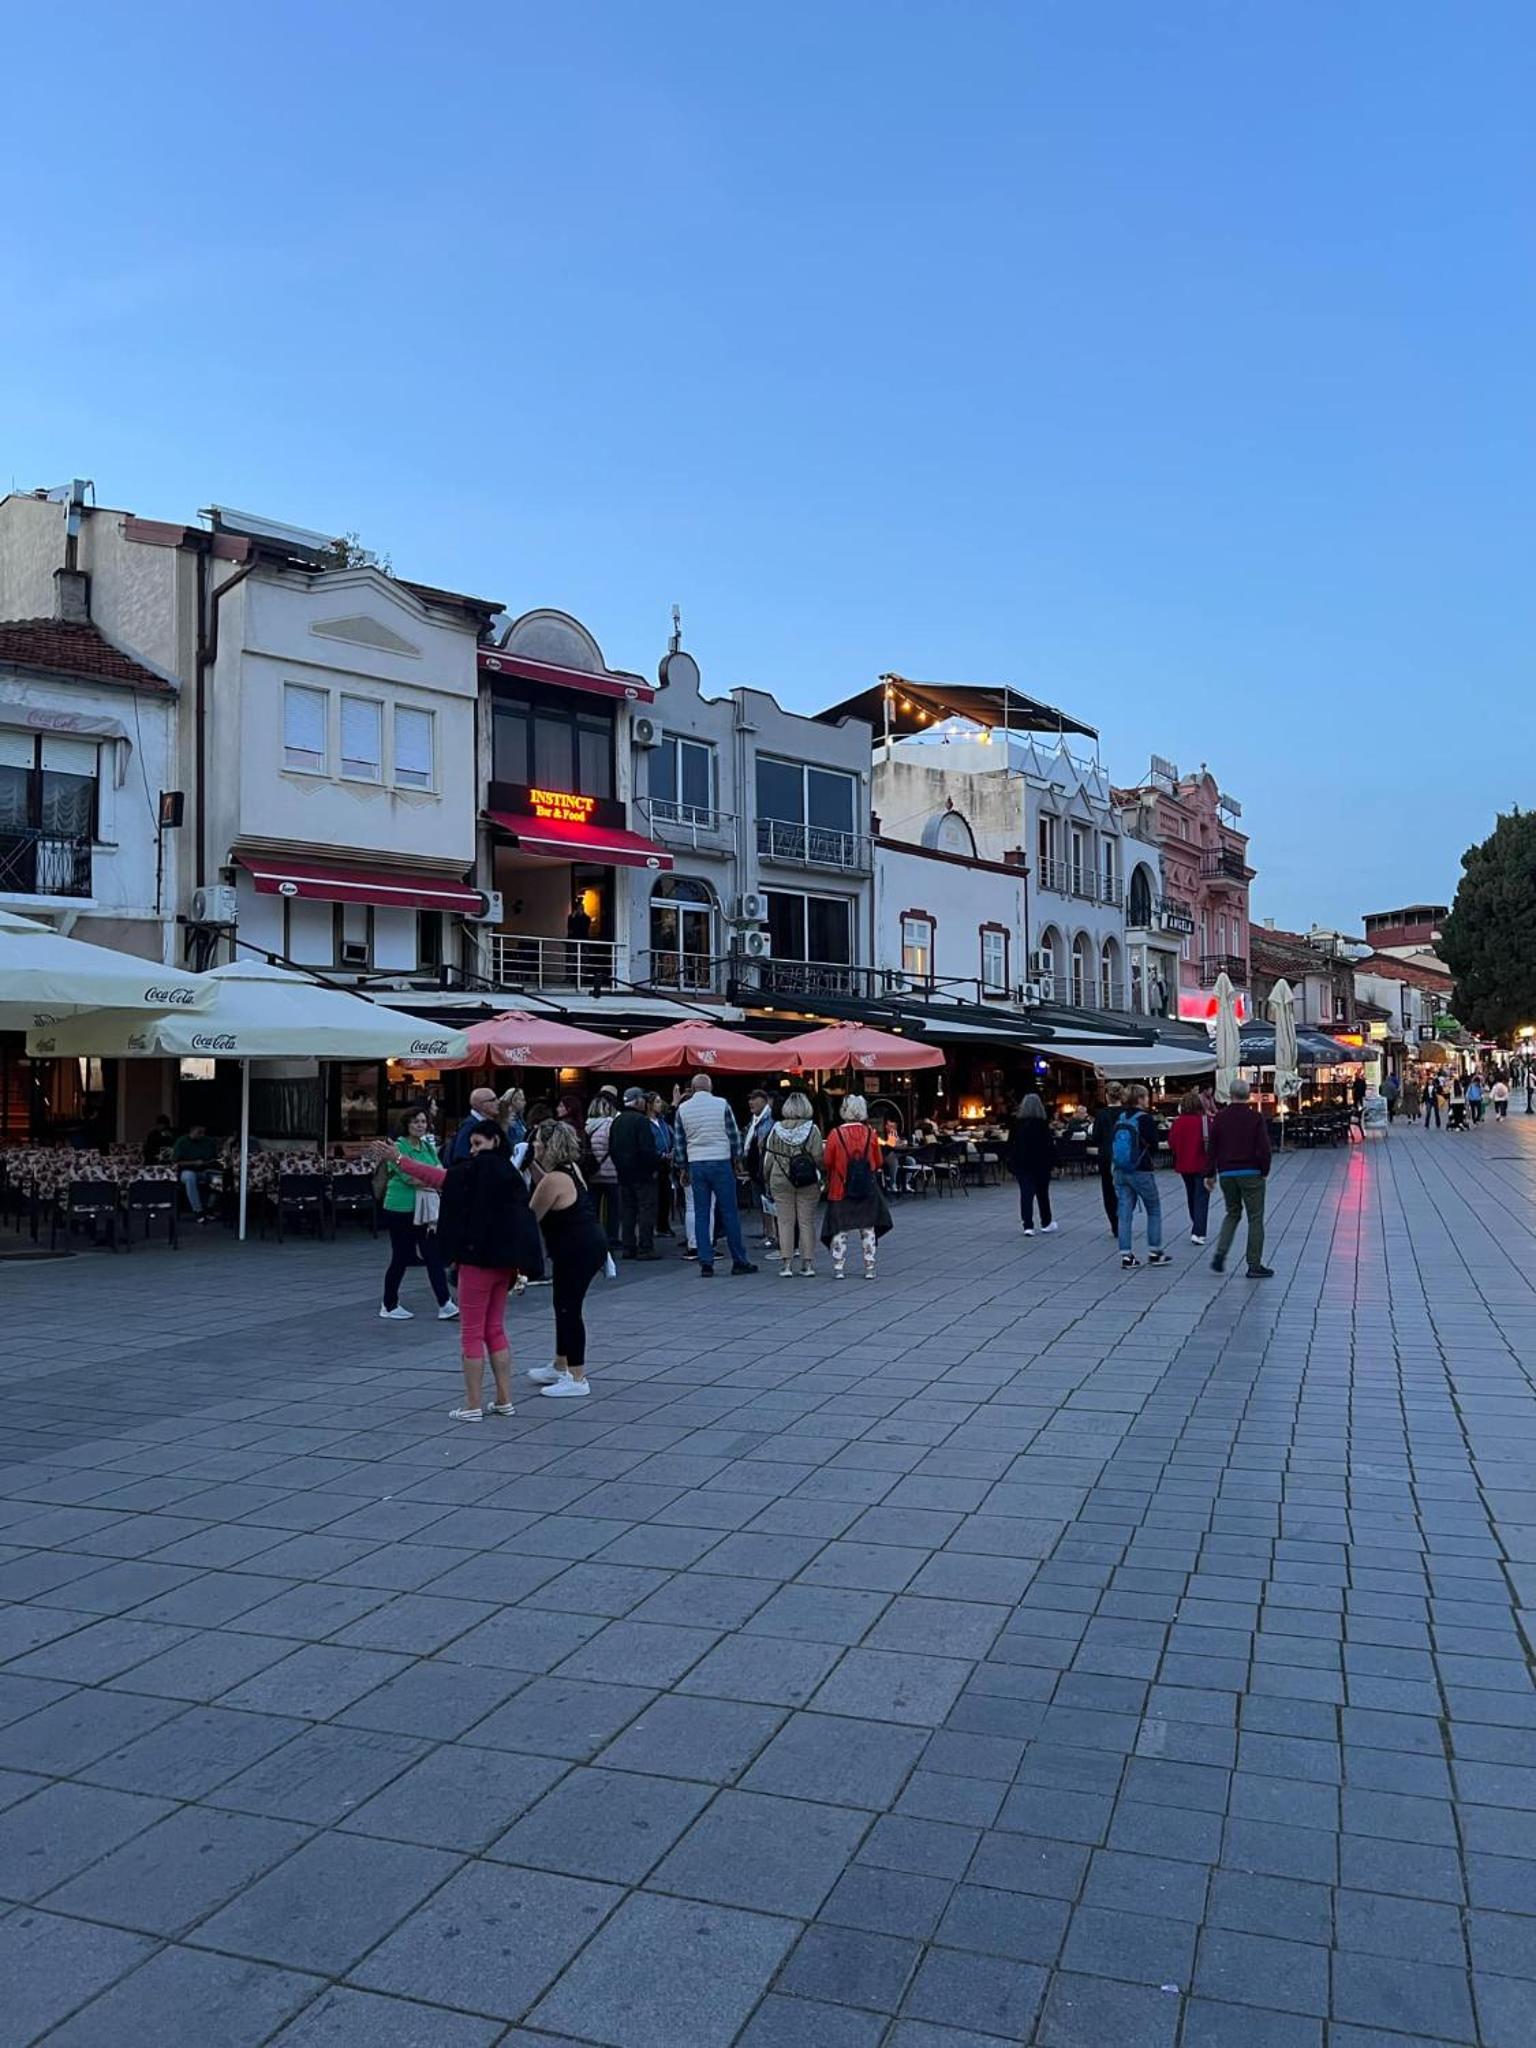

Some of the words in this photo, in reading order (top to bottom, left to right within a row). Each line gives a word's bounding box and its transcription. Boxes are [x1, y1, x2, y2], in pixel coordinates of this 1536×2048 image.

[530, 789, 594, 811] INSTINCT
[536, 805, 552, 817] Bar
[553, 807, 562, 819] &
[563, 809, 586, 823] Food
